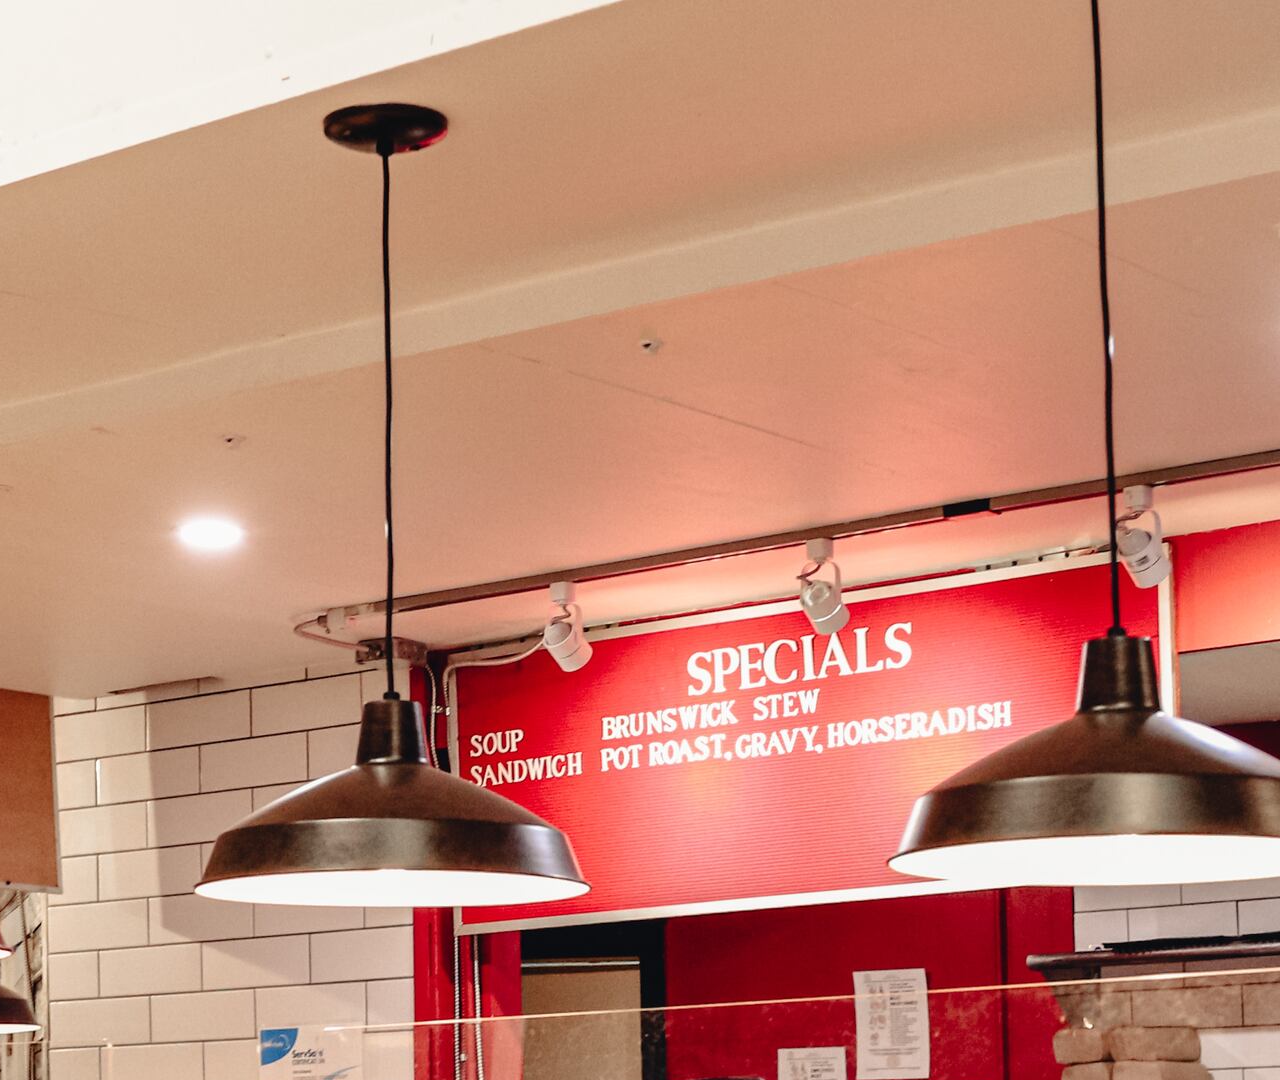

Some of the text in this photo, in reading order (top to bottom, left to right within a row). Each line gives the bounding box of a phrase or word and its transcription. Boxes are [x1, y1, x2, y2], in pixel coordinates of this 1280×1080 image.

[686, 621, 913, 697] SPECIALS
[469, 687, 821, 758] SOUP BRUNSWICK STEW
[469, 700, 1013, 789] SANDWICH POT ROAST, GRAVY, HORSERADISH
